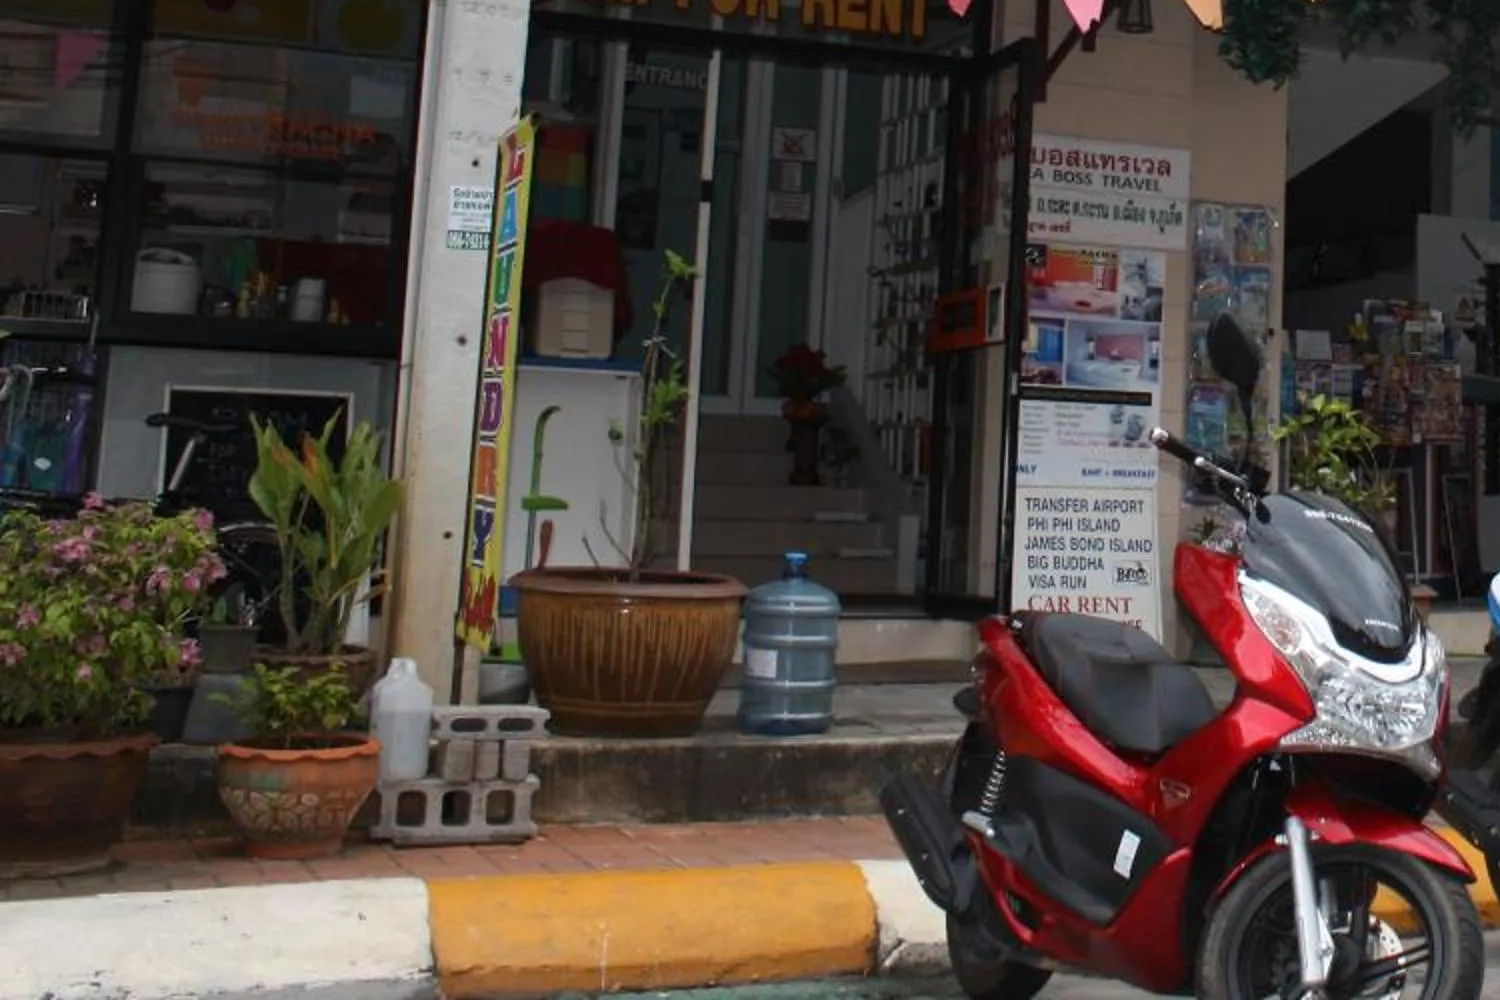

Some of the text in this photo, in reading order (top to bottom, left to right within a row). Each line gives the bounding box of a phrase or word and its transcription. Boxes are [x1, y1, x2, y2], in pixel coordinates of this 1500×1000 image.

[625, 62, 708, 90] ENTRANC
[1030, 167, 1162, 192] A BOSS TRAVEL
[1025, 497, 1144, 514] TRANSFER AIRPORT
[1027, 517, 1121, 533] PHI PHI ISLAND
[1024, 535, 1153, 553] JAMES BOND ISLAND
[1027, 555, 1105, 571] BIG BUDDHA
[1028, 574, 1087, 589] VISA RUN
[1028, 595, 1133, 614] CAR RENT
